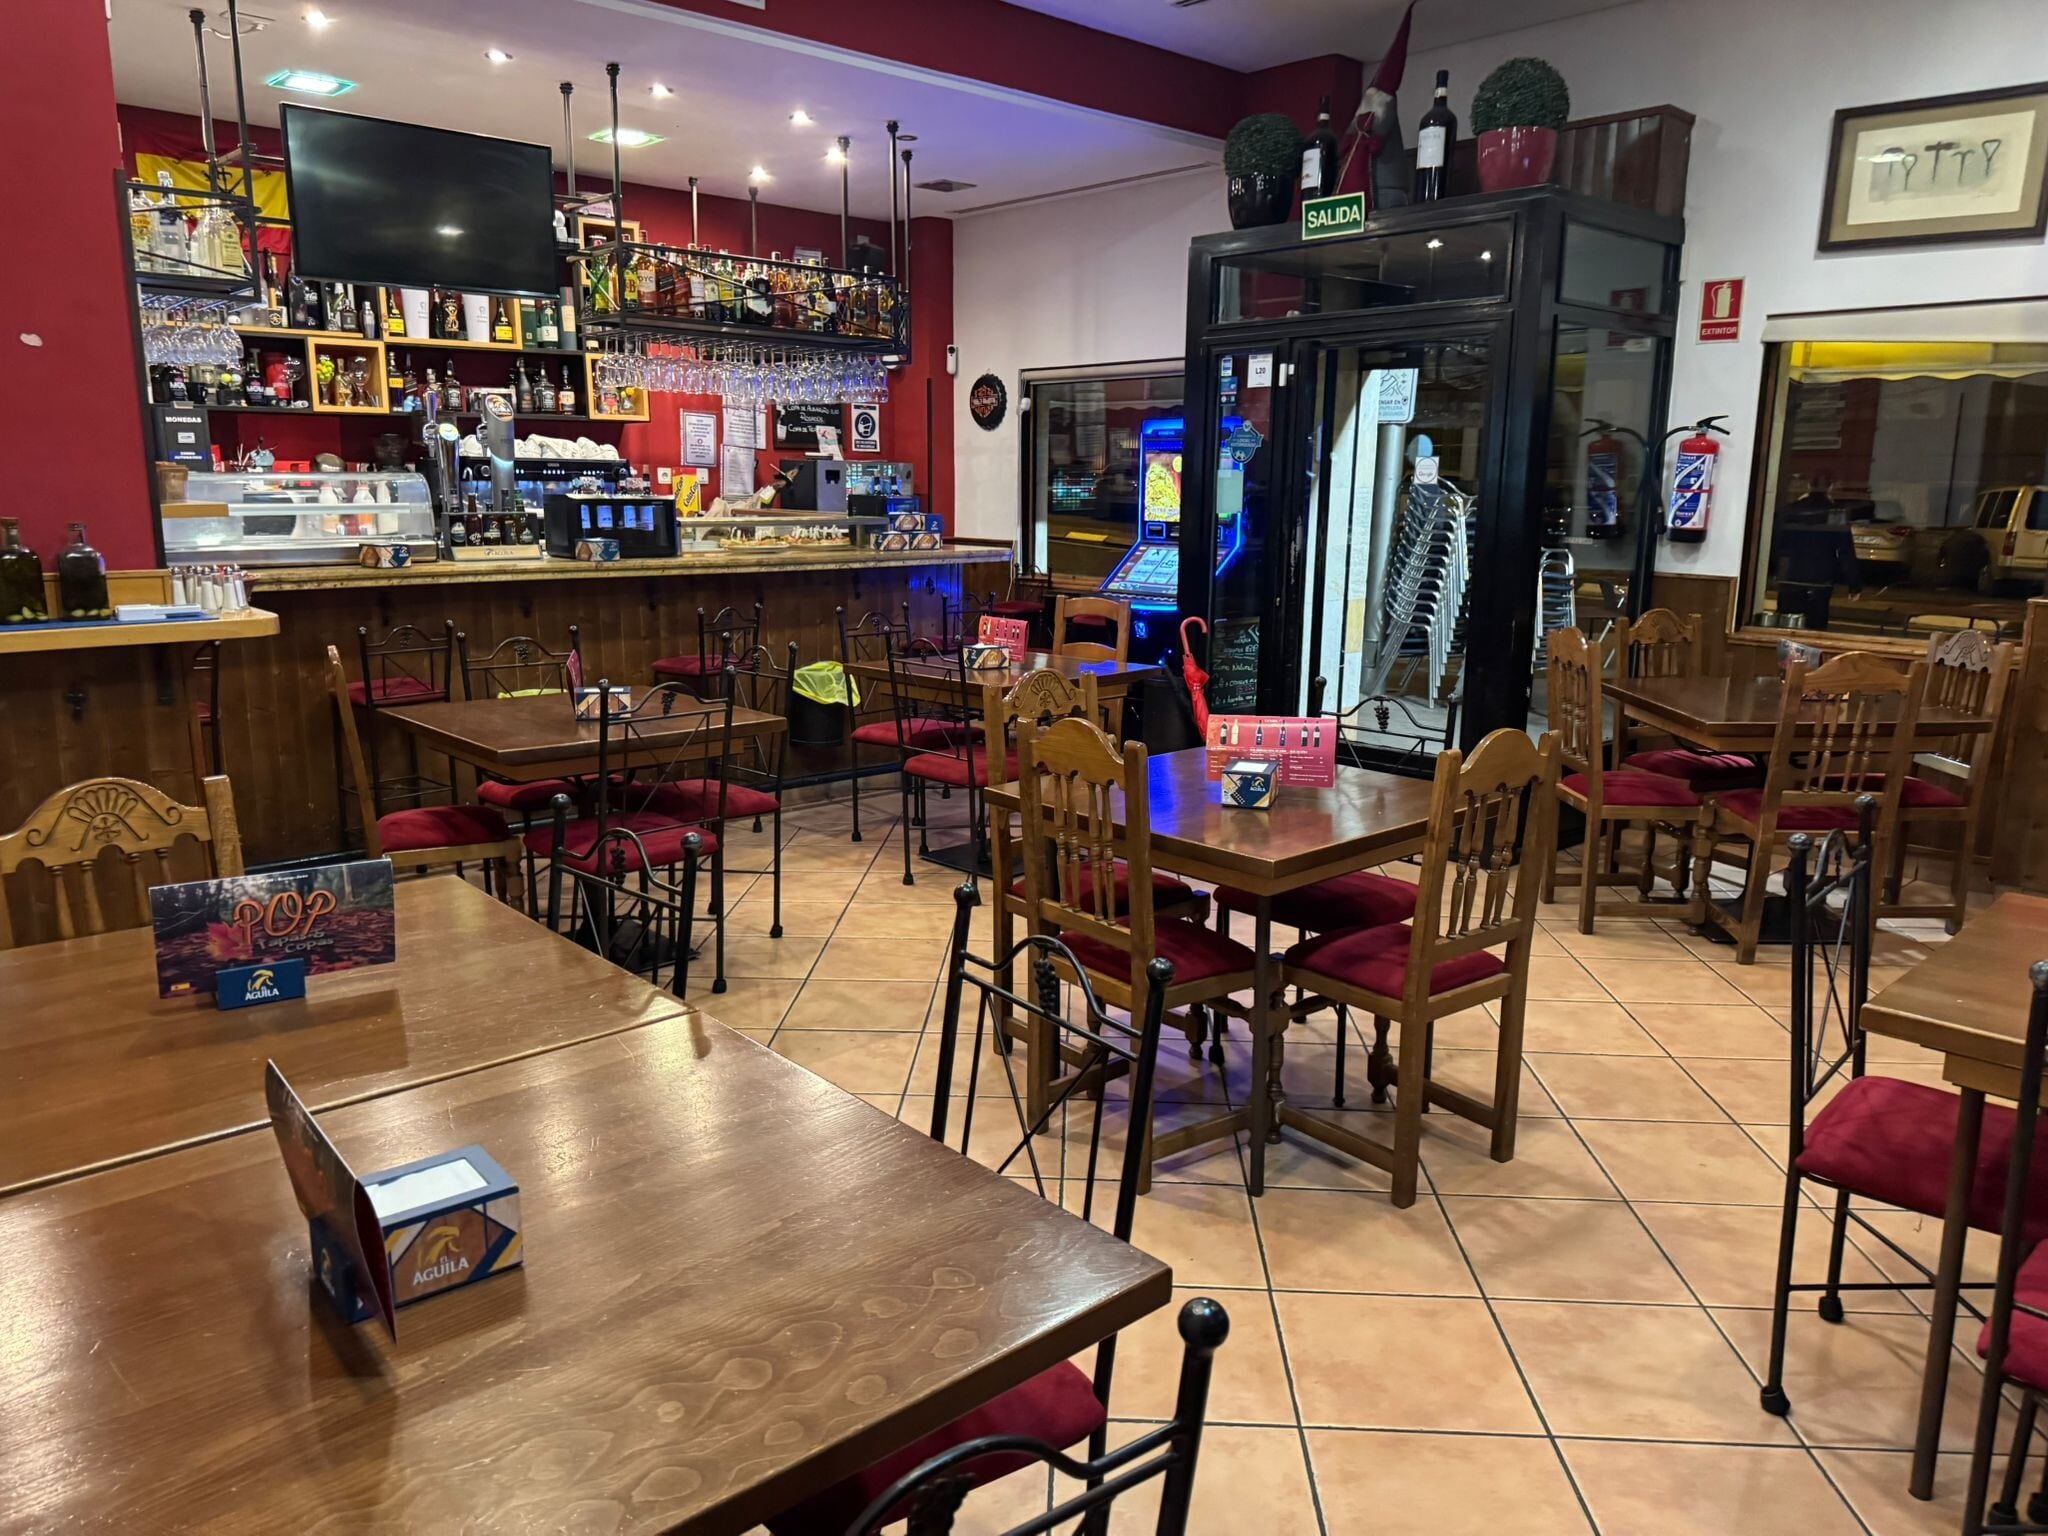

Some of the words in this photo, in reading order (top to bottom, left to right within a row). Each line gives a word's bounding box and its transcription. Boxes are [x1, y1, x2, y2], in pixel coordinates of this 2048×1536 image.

[1307, 205, 1361, 228] SALIDA
[639, 274, 653, 282] DYC
[1701, 326, 1738, 336] EXTINTOR
[1255, 367, 1266, 375] L20
[683, 481, 699, 507] ColaCao
[232, 890, 337, 946] POP
[285, 938, 334, 953] Copas
[245, 988, 279, 1000] AGUILA
[413, 1257, 469, 1285] AGUILA
